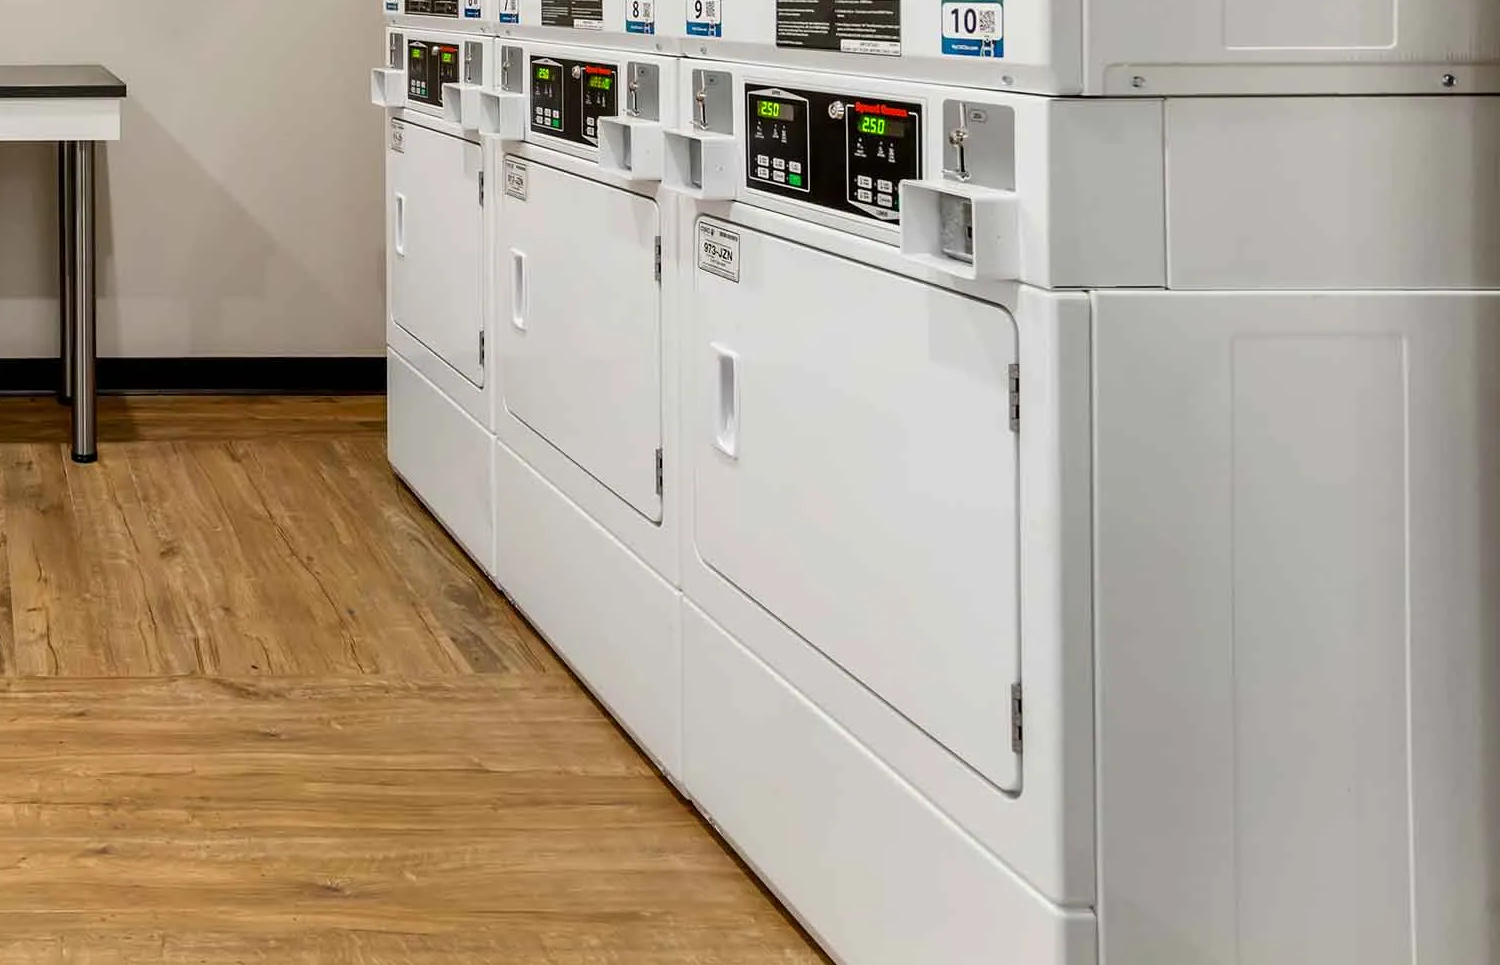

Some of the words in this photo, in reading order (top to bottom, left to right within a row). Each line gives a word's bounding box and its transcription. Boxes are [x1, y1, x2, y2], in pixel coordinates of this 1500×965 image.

[632, 0, 639, 19] 8
[694, 0, 703, 19] 9
[950, 7, 977, 34] 10
[761, 101, 780, 117] 2.50
[862, 117, 885, 135] 2.50
[703, 242, 733, 262] 973-JZN
